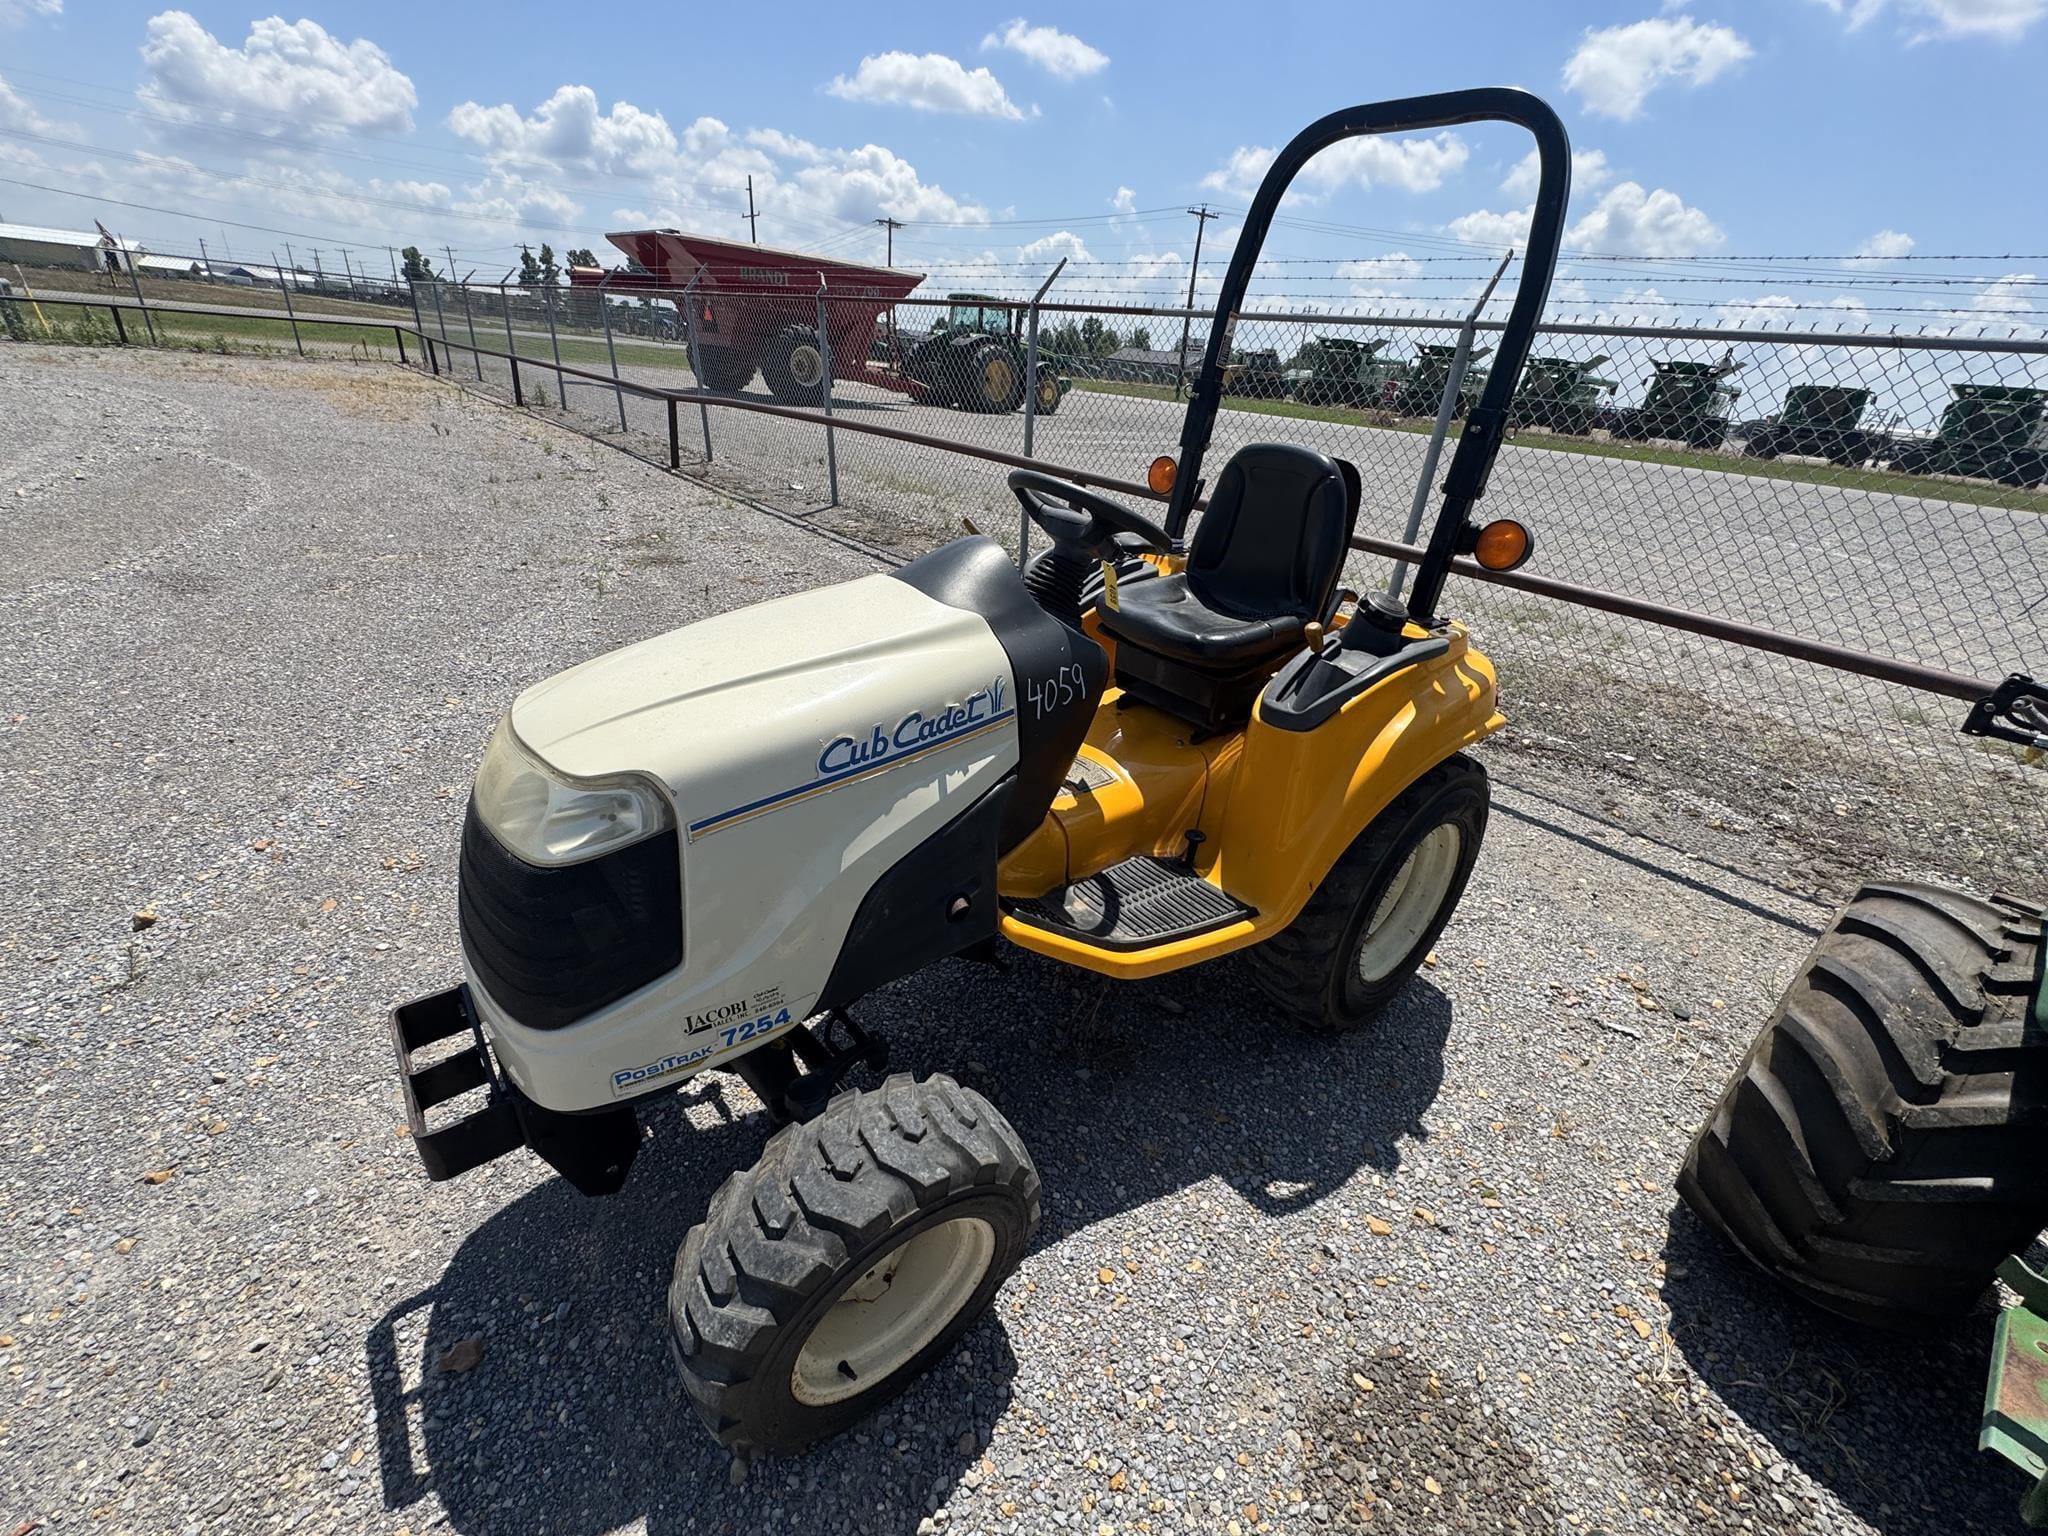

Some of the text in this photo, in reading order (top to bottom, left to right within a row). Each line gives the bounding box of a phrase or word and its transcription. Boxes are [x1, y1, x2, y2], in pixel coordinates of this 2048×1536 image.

[740, 266, 790, 286] BRANDT
[1027, 663, 1087, 720] 4059
[818, 693, 988, 774] Cub Cadet
[683, 1000, 748, 1033] JACOBI
[719, 1007, 792, 1047] 7254
